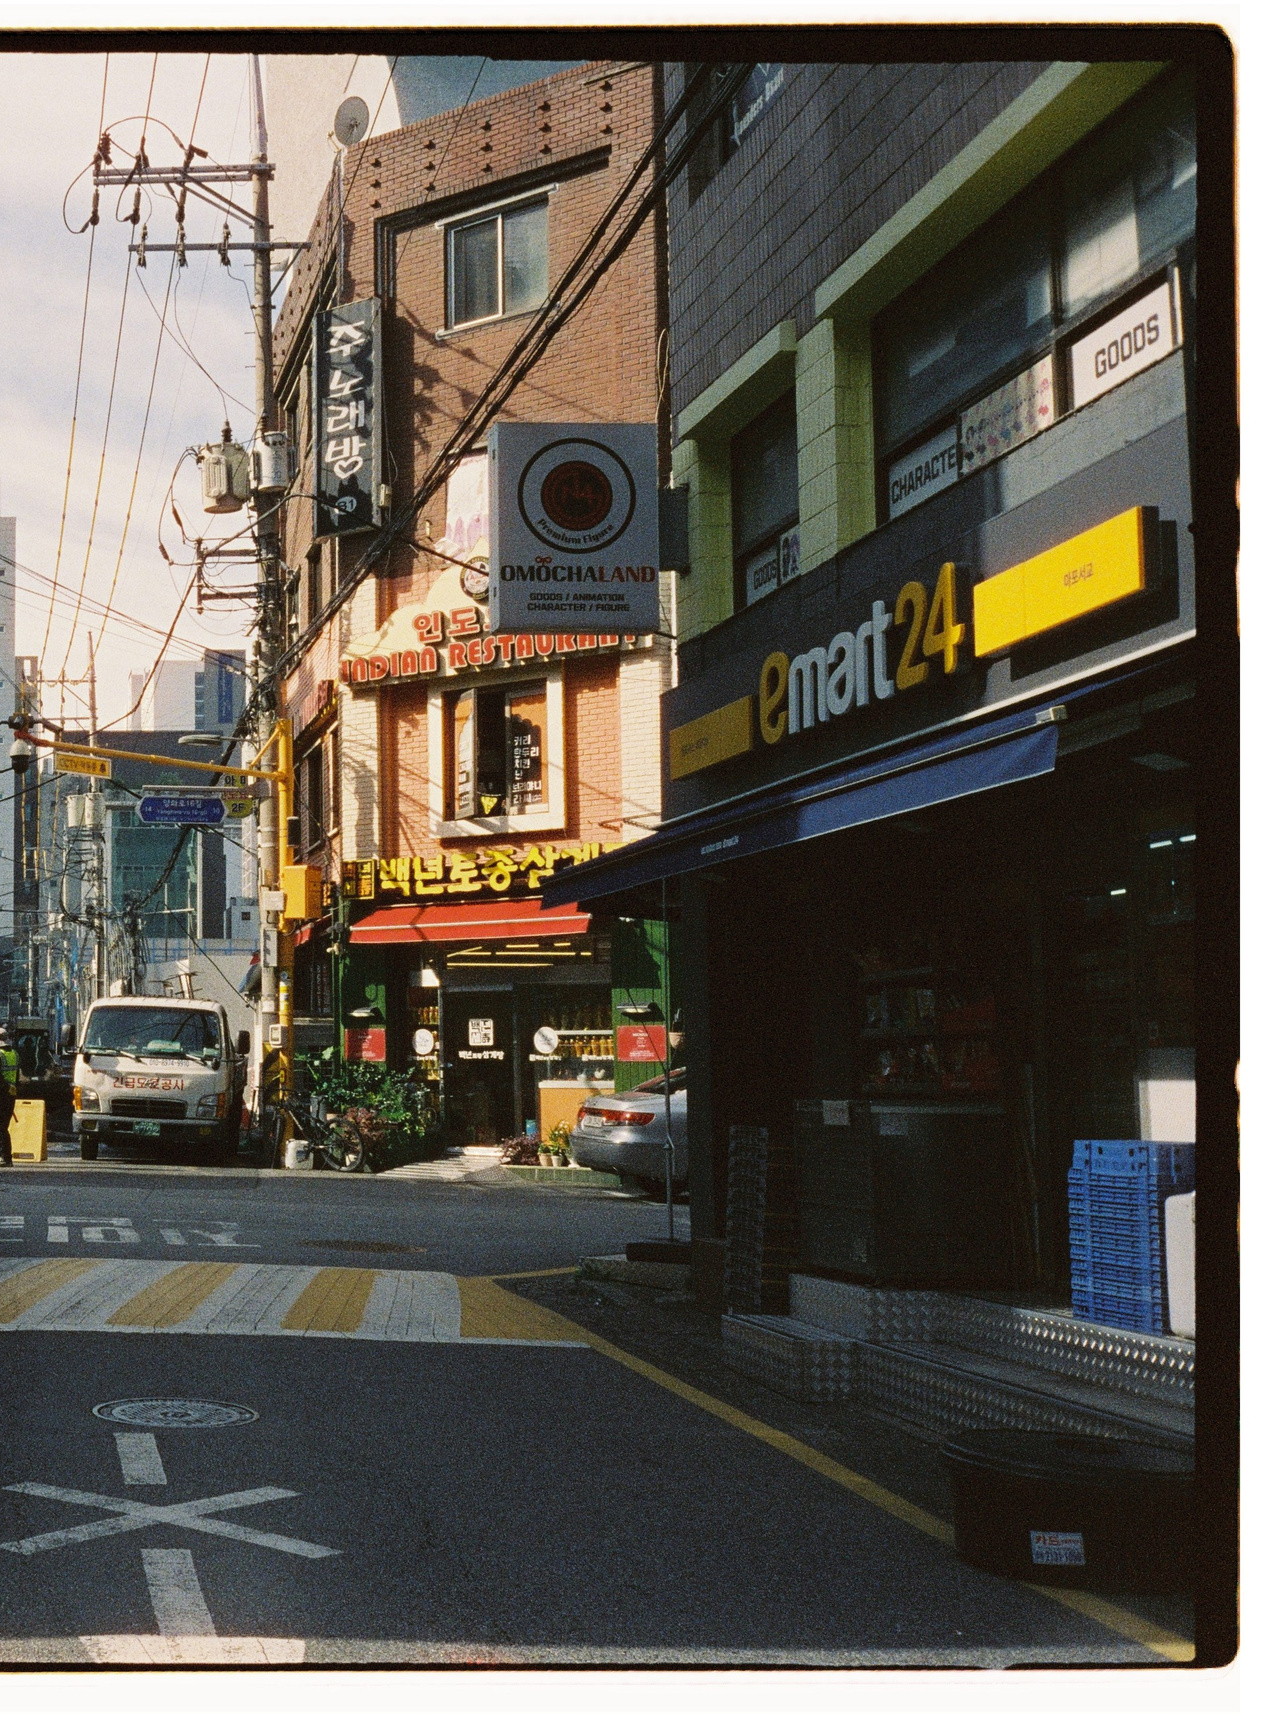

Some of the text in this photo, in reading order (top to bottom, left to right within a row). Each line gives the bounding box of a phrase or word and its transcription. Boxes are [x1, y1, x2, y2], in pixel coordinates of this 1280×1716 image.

[1093, 314, 1161, 380] GOODS
[325, 320, 367, 481] 주노래방
[537, 518, 614, 545] Premium Figure
[500, 563, 656, 584] OMOCHALAND
[527, 602, 587, 612] CHARACTER
[595, 602, 630, 612] FIGURE
[528, 592, 563, 602] GOODS
[572, 592, 625, 602] ANIMATION
[412, 605, 490, 645] 인도
[341, 646, 438, 684] INDIAN
[758, 561, 965, 745] emart24
[231, 803, 246, 813] 2F
